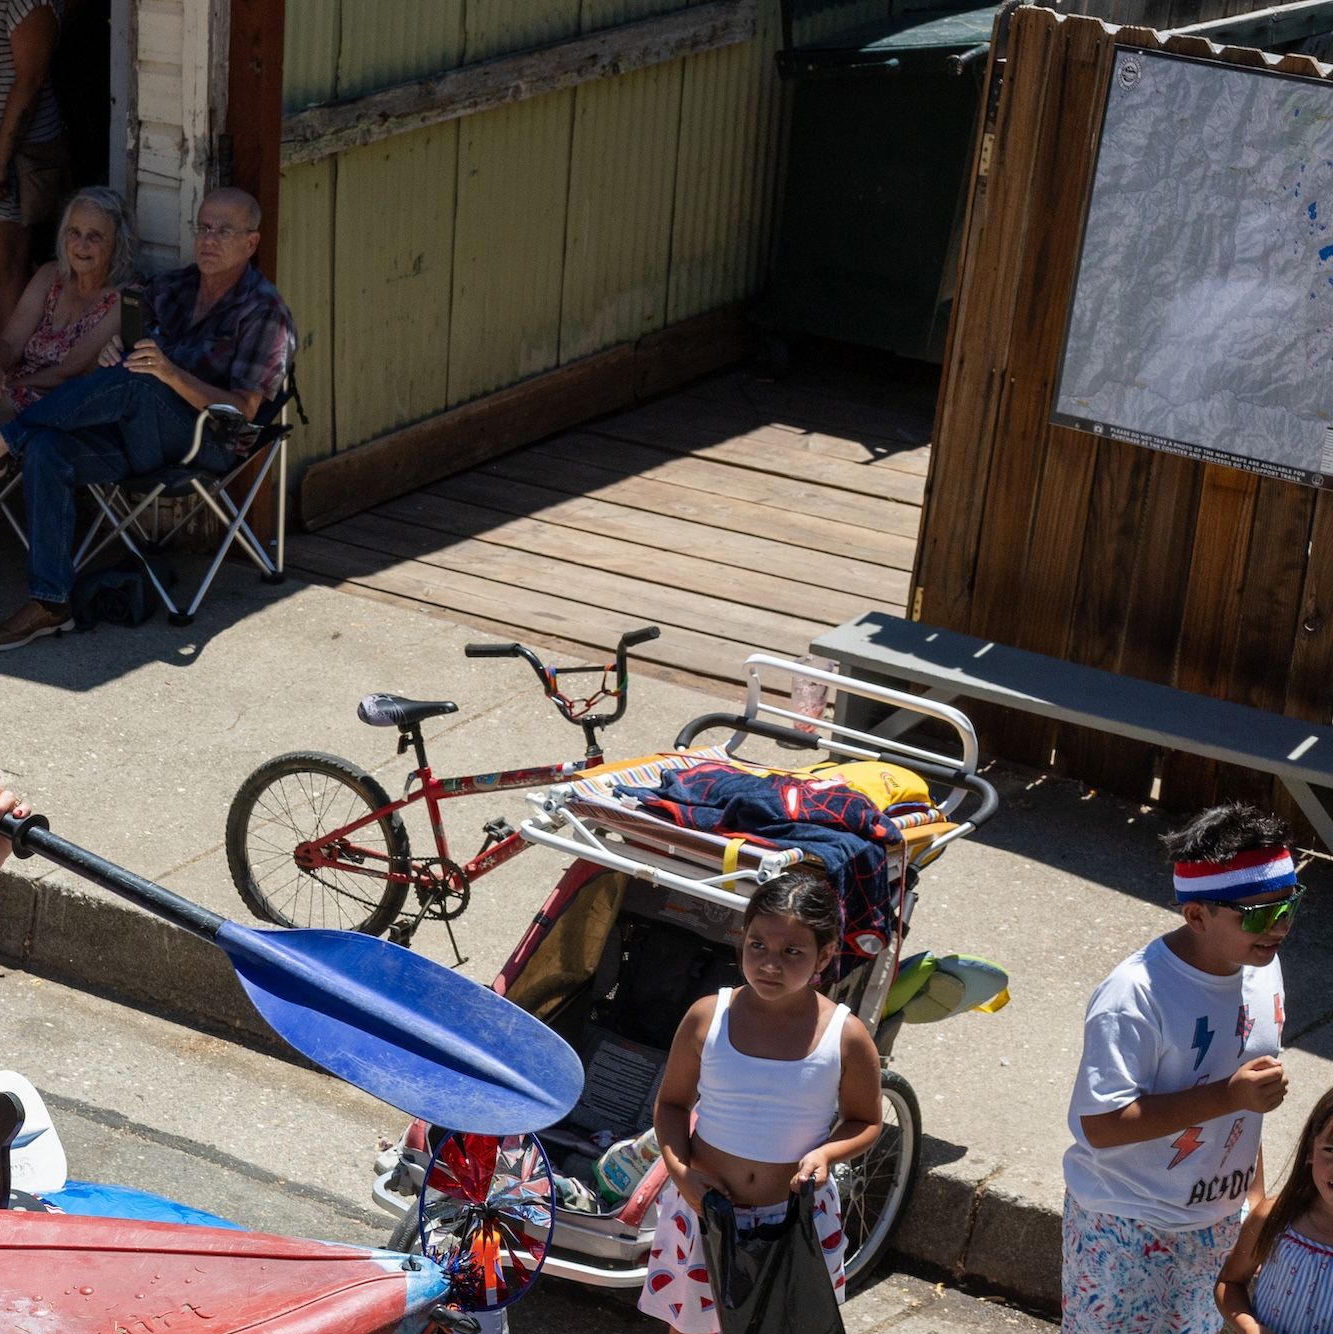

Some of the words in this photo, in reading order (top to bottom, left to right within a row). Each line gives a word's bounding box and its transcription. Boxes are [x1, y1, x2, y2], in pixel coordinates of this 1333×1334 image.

[1110, 427, 1130, 437] PLEASE
[1153, 437, 1167, 445] TAKE
[1174, 442, 1192, 451] PHOTO
[1231, 455, 1247, 464] MAPS
[1261, 462, 1292, 475] AVAILABLE
[1111, 433, 1140, 444] PURCHASE
[1162, 446, 1187, 456] COUNTER
[1202, 455, 1231, 466] PROCEEDS
[1253, 467, 1278, 478] SUPPORT
